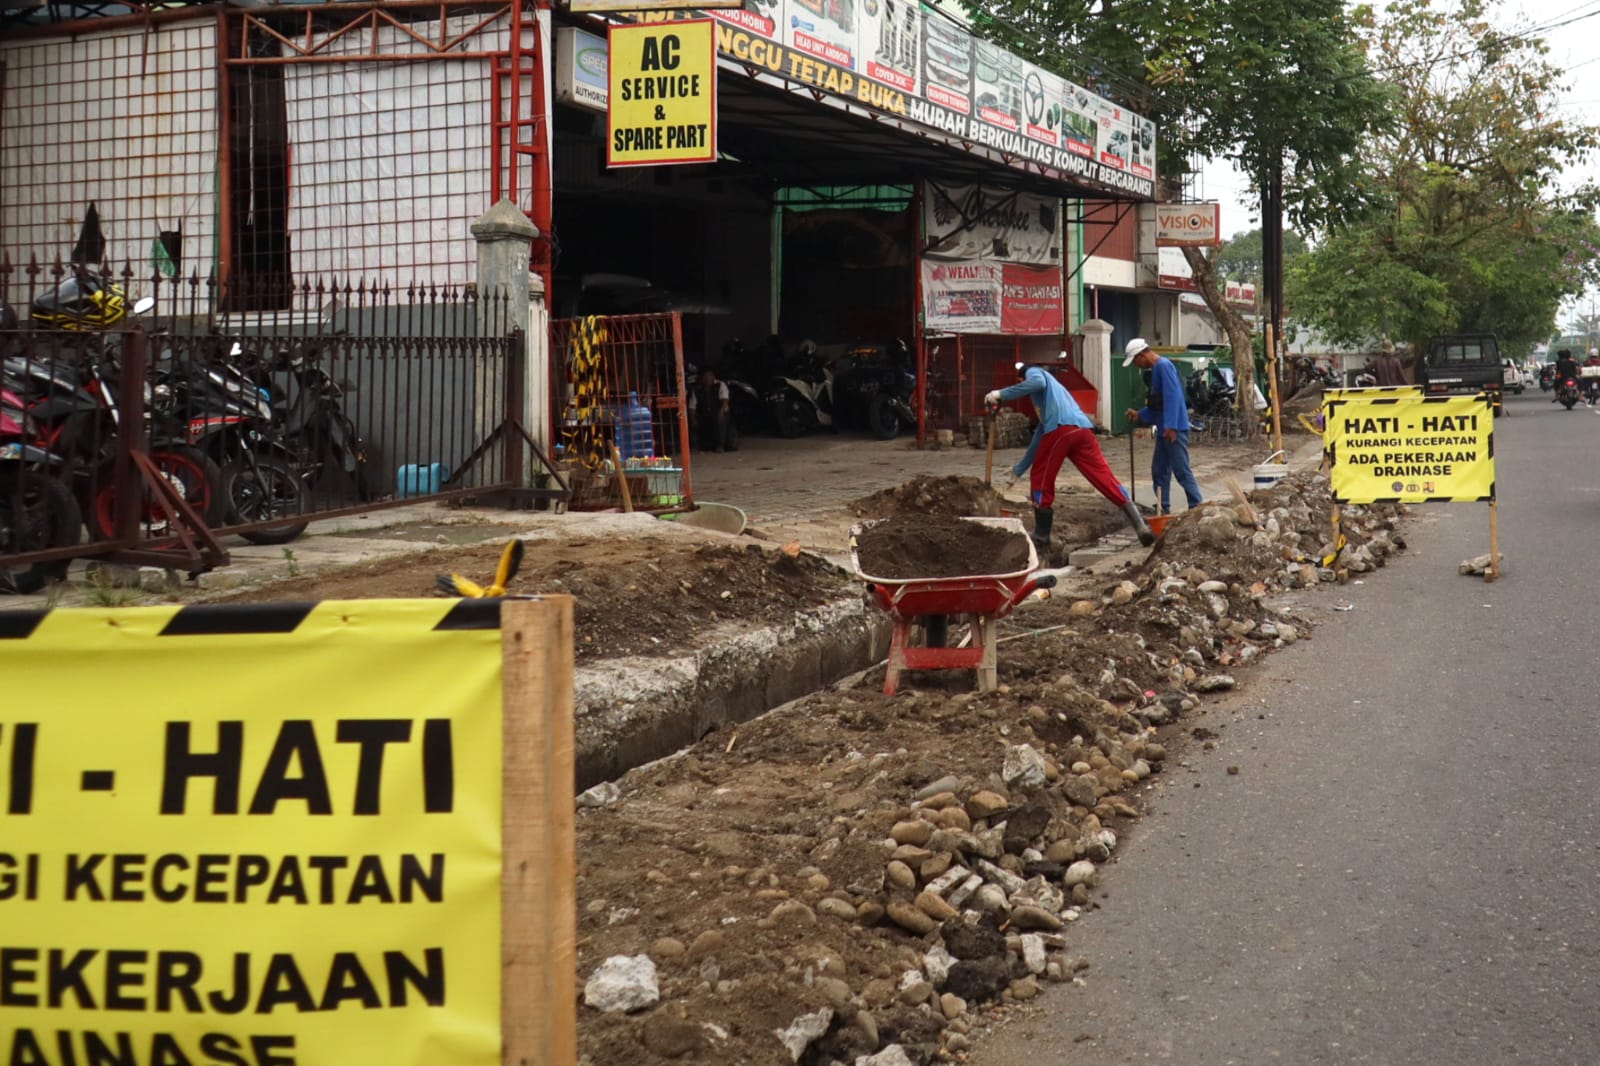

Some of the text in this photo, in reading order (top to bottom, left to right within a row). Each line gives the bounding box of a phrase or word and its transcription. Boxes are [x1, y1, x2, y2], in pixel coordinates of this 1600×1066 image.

[741, 11, 767, 33] MOBIL
[640, 34, 681, 72] AC
[621, 74, 700, 101] SERVICE
[655, 104, 667, 121] &
[788, 51, 854, 94] TETAP
[857, 78, 907, 116] BUKA
[910, 98, 966, 138] MURAH
[969, 119, 1052, 166] BERKUALITAS
[1053, 150, 1099, 181] KOMPLIT
[1098, 164, 1153, 197] BERGARANSI
[614, 124, 708, 152] SPARE PART
[1158, 213, 1213, 231] VISION
[1344, 417, 1399, 434] HATI
[1422, 415, 1477, 432] HATI
[1346, 436, 1477, 448] KURANGI KECEPATAN
[1348, 451, 1477, 465] ADA PEKERJAAN
[1374, 465, 1452, 477] DRAINASE
[0, 722, 38, 815] I
[159, 718, 455, 816] HATI
[64, 853, 445, 905] KECEPATAN
[0, 946, 446, 1015] EKERJAAN
